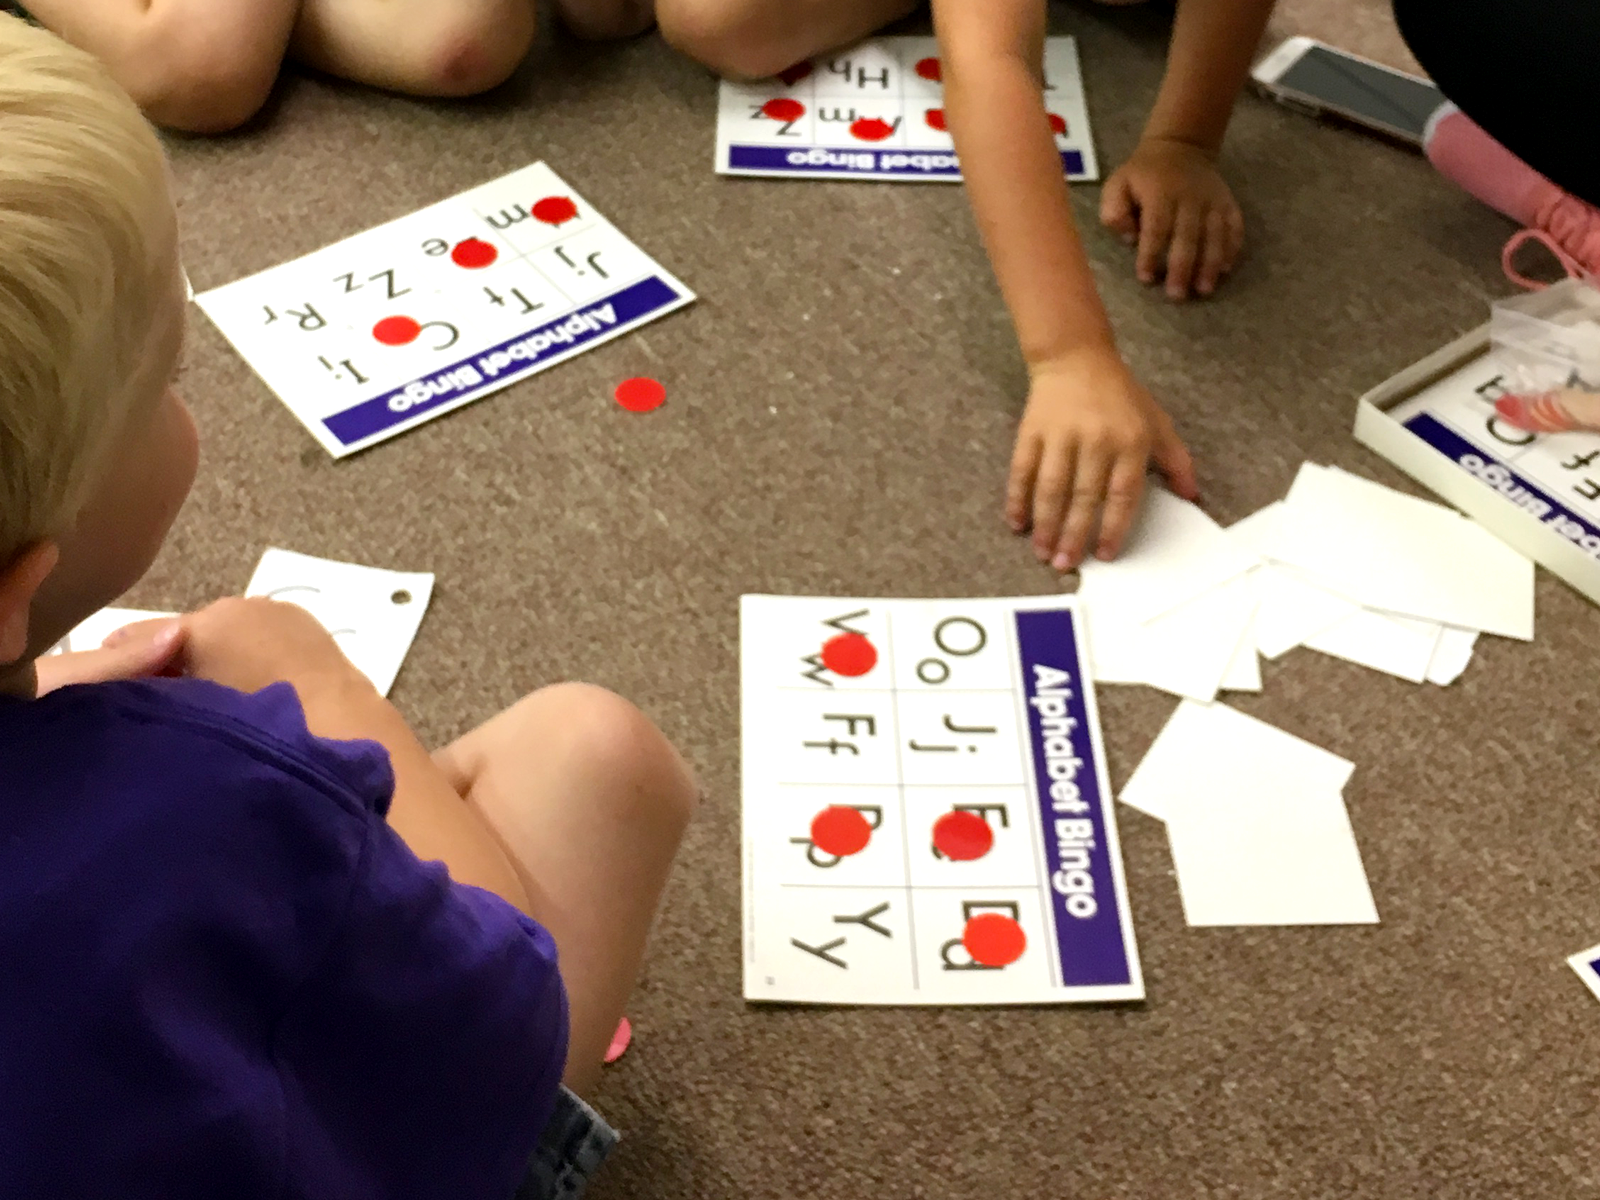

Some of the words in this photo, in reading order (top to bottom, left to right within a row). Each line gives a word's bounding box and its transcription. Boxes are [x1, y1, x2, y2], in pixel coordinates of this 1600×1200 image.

[787, 149, 876, 171] Bingo
[553, 246, 610, 280] Jj
[332, 269, 412, 300] Zz
[482, 286, 545, 315] Tt
[262, 302, 327, 332] Rr
[480, 304, 619, 377] Alphabet
[317, 355, 370, 385] Ii
[387, 363, 483, 412] Bingo
[916, 616, 987, 684] Oo
[803, 713, 876, 756] Ff
[908, 714, 998, 753] Jj
[1030, 664, 1090, 812] Alphabet
[1052, 818, 1098, 919] Bingo
[791, 902, 892, 970] Yy
